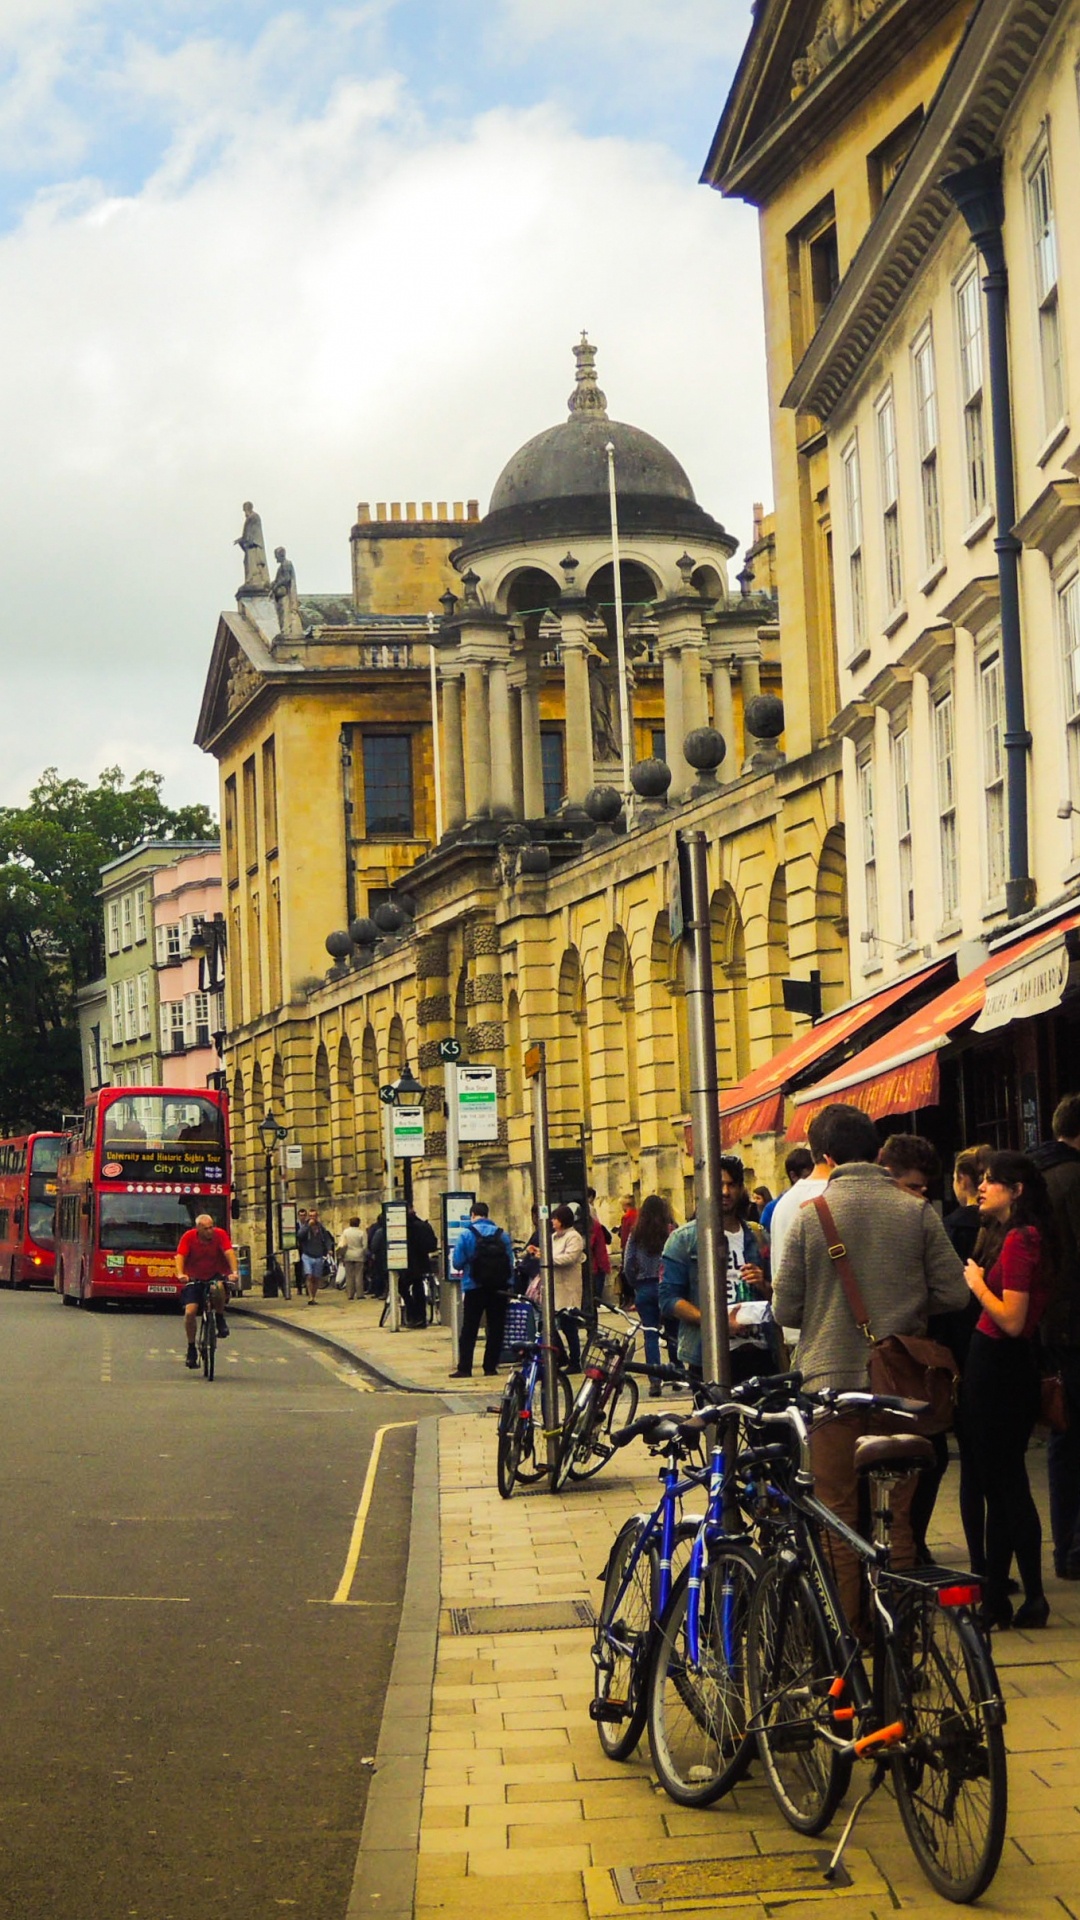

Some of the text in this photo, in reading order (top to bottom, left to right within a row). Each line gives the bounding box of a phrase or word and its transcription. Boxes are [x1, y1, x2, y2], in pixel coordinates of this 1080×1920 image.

[440, 1041, 459, 1055] K5
[380, 1089, 395, 1099] K4
[277, 1128, 286, 1137] K3
[106, 1151, 221, 1164] University and Historic Sights Tour
[153, 1164, 200, 1174] City Tour
[210, 1184, 223, 1194] 55
